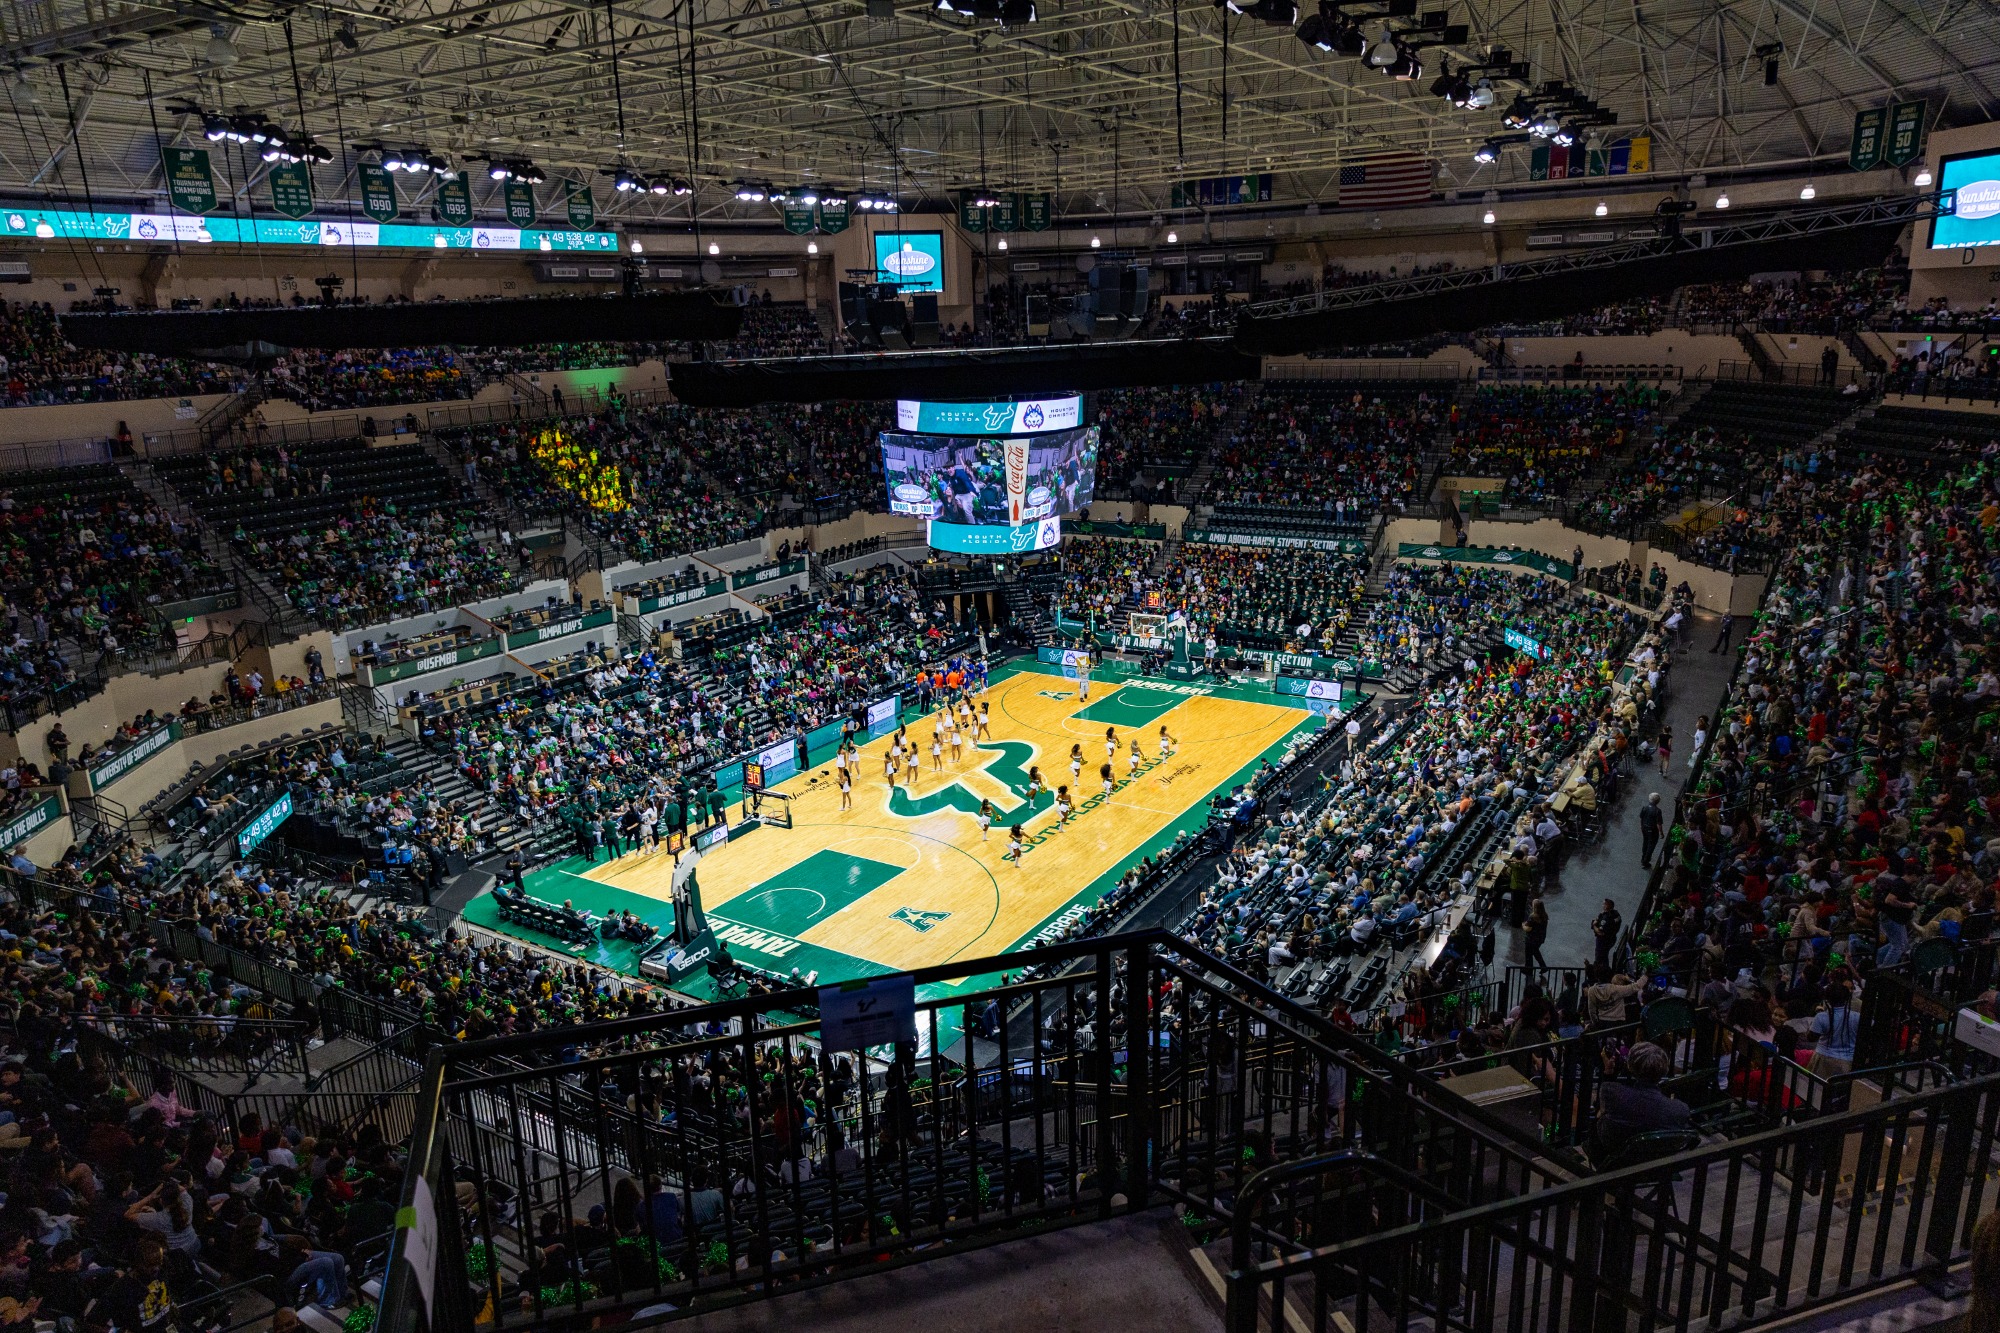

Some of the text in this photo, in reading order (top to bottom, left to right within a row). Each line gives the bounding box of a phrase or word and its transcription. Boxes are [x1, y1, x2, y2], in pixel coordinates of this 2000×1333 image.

[1859, 137, 1875, 154] 33
[1895, 131, 1912, 148] 50
[172, 179, 210, 188] TOURNAMENT
[174, 186, 212, 196] CHAMPIONS
[1956, 188, 2000, 204] Sunshin
[368, 199, 392, 211] 1990
[446, 203, 467, 214] 1992
[822, 205, 846, 213] BOWERS
[1961, 202, 2000, 213] CAR WASH
[511, 206, 530, 218] 2012
[968, 209, 980, 220] 30
[1001, 209, 1010, 219] 31
[1032, 208, 1042, 219] 12
[552, 232, 564, 242] 49
[565, 232, 582, 240] 5:38
[584, 234, 596, 243] 42
[889, 255, 928, 265] Sunshine
[1962, 247, 1975, 265] D
[281, 281, 297, 290] 319
[503, 281, 516, 290] 320
[1007, 444, 1024, 495] Coca-Cola
[1443, 480, 1468, 488] 219
[1208, 533, 1226, 543] AMIR
[1227, 534, 1275, 546] ABDUR-RAHIM
[1276, 537, 1308, 549] STUDENT
[755, 567, 780, 581] @USFWBB
[217, 597, 237, 608] 213
[658, 586, 706, 608] HOME FOR HOOPS
[1148, 597, 1158, 606] 30
[538, 619, 583, 640] TAMPA BAY'S
[1110, 634, 1131, 645] AIR
[417, 651, 457, 671] @USFMBB
[1277, 653, 1312, 667] SECTION
[1123, 678, 1214, 695] TAMPA BAY
[95, 728, 170, 786] UNIVERSITY OF SOUTH FLORIDA
[747, 772, 760, 785] 30
[3, 806, 47, 845] OF THE BULLS
[251, 822, 260, 836] 49
[272, 804, 281, 818] 42
[715, 924, 801, 957] TAMPA
[677, 946, 710, 971] GEICO
